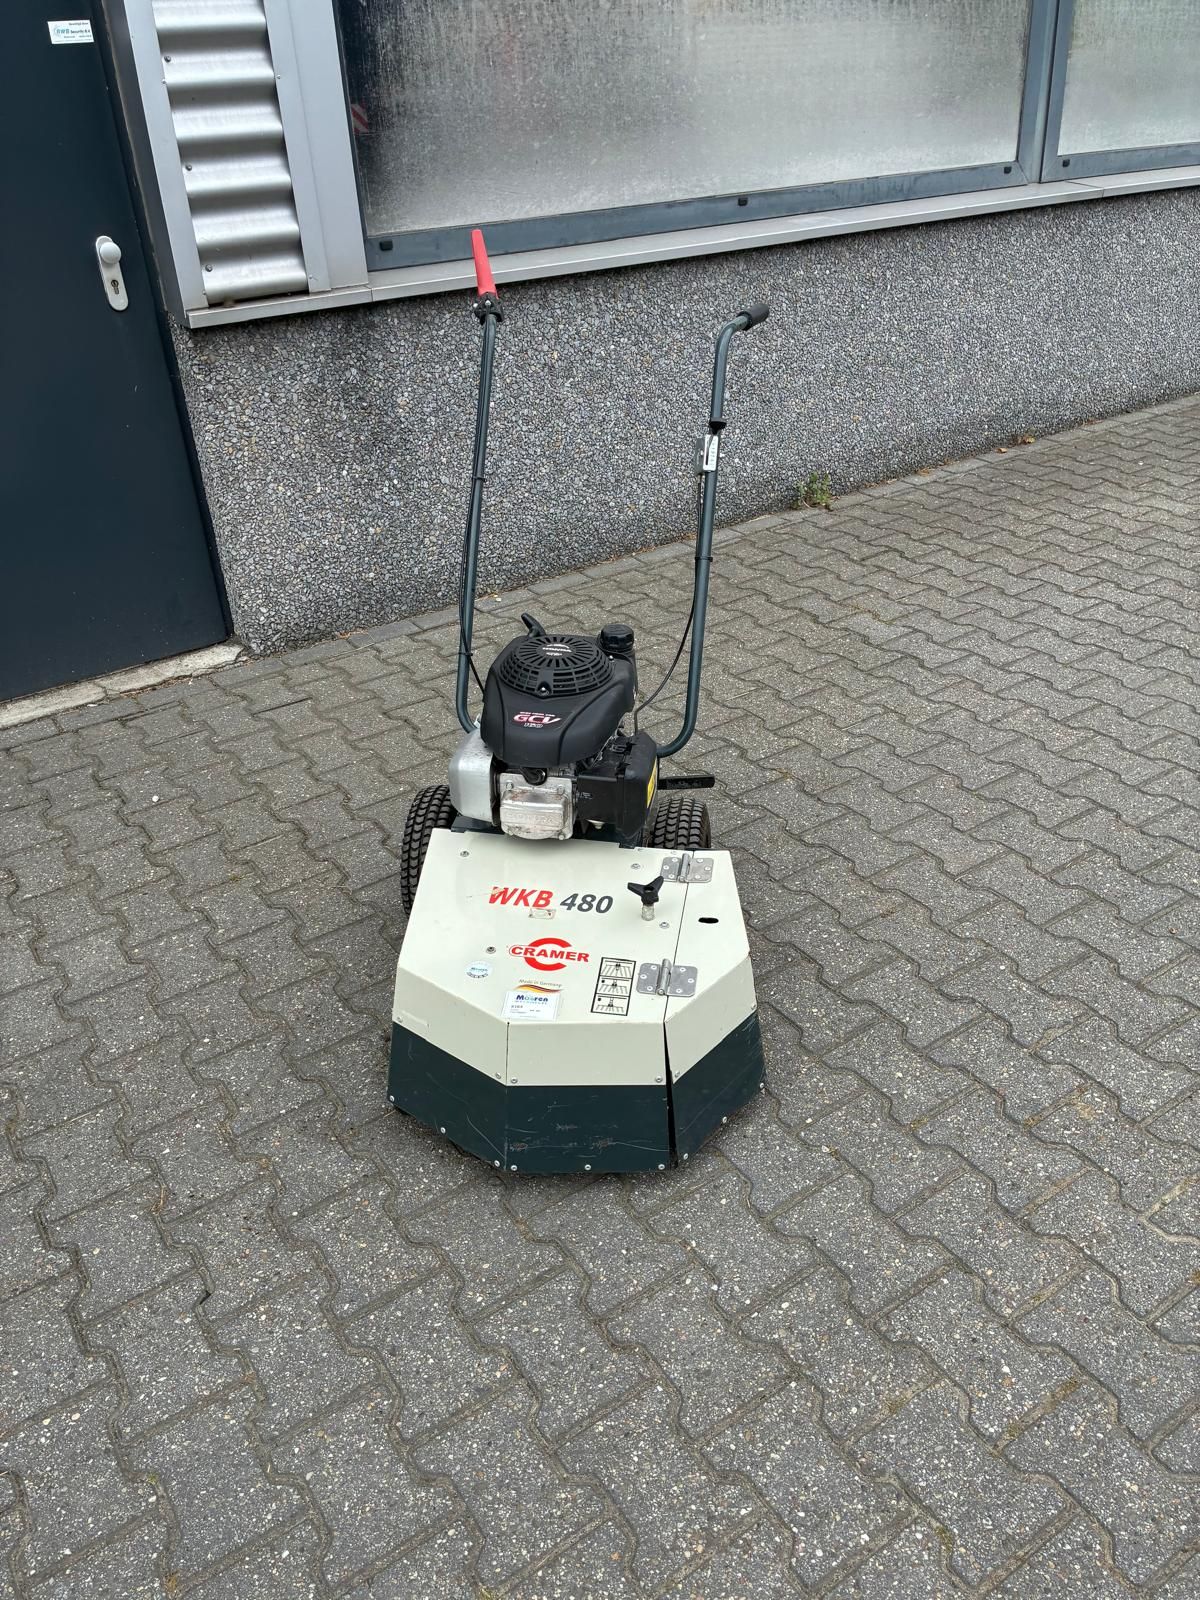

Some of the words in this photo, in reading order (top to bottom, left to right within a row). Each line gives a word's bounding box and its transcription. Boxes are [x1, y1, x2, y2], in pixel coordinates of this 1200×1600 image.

[513, 714, 563, 725] GCV
[489, 886, 553, 908] WKB
[560, 893, 614, 914] 480
[511, 946, 590, 962] CRAMER
